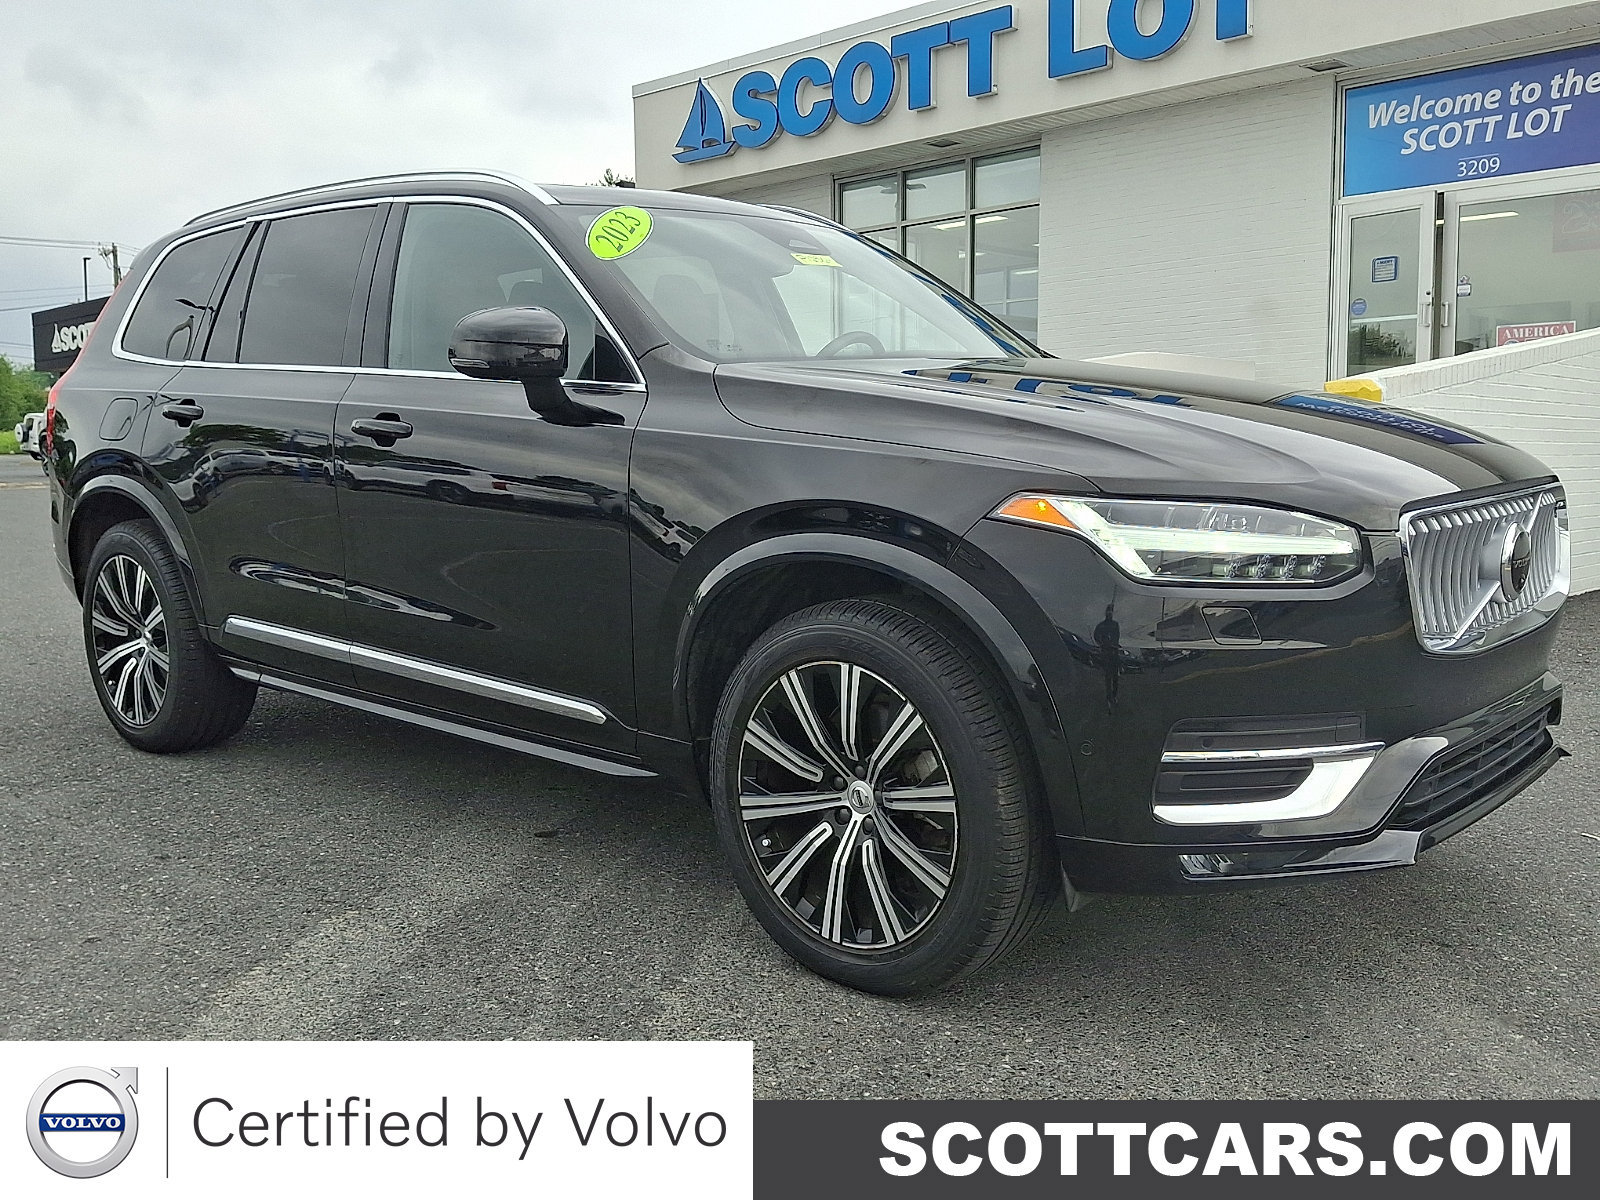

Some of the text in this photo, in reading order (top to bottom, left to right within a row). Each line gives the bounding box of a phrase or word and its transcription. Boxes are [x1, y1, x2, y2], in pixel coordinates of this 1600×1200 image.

[732, 4, 1013, 149] SCOTT
[1368, 68, 1600, 129] Welcome to the
[1400, 104, 1573, 155] SCOTT LOT
[1456, 156, 1501, 178] 3209
[595, 211, 641, 253] 2023
[1502, 324, 1570, 339] AMERICA
